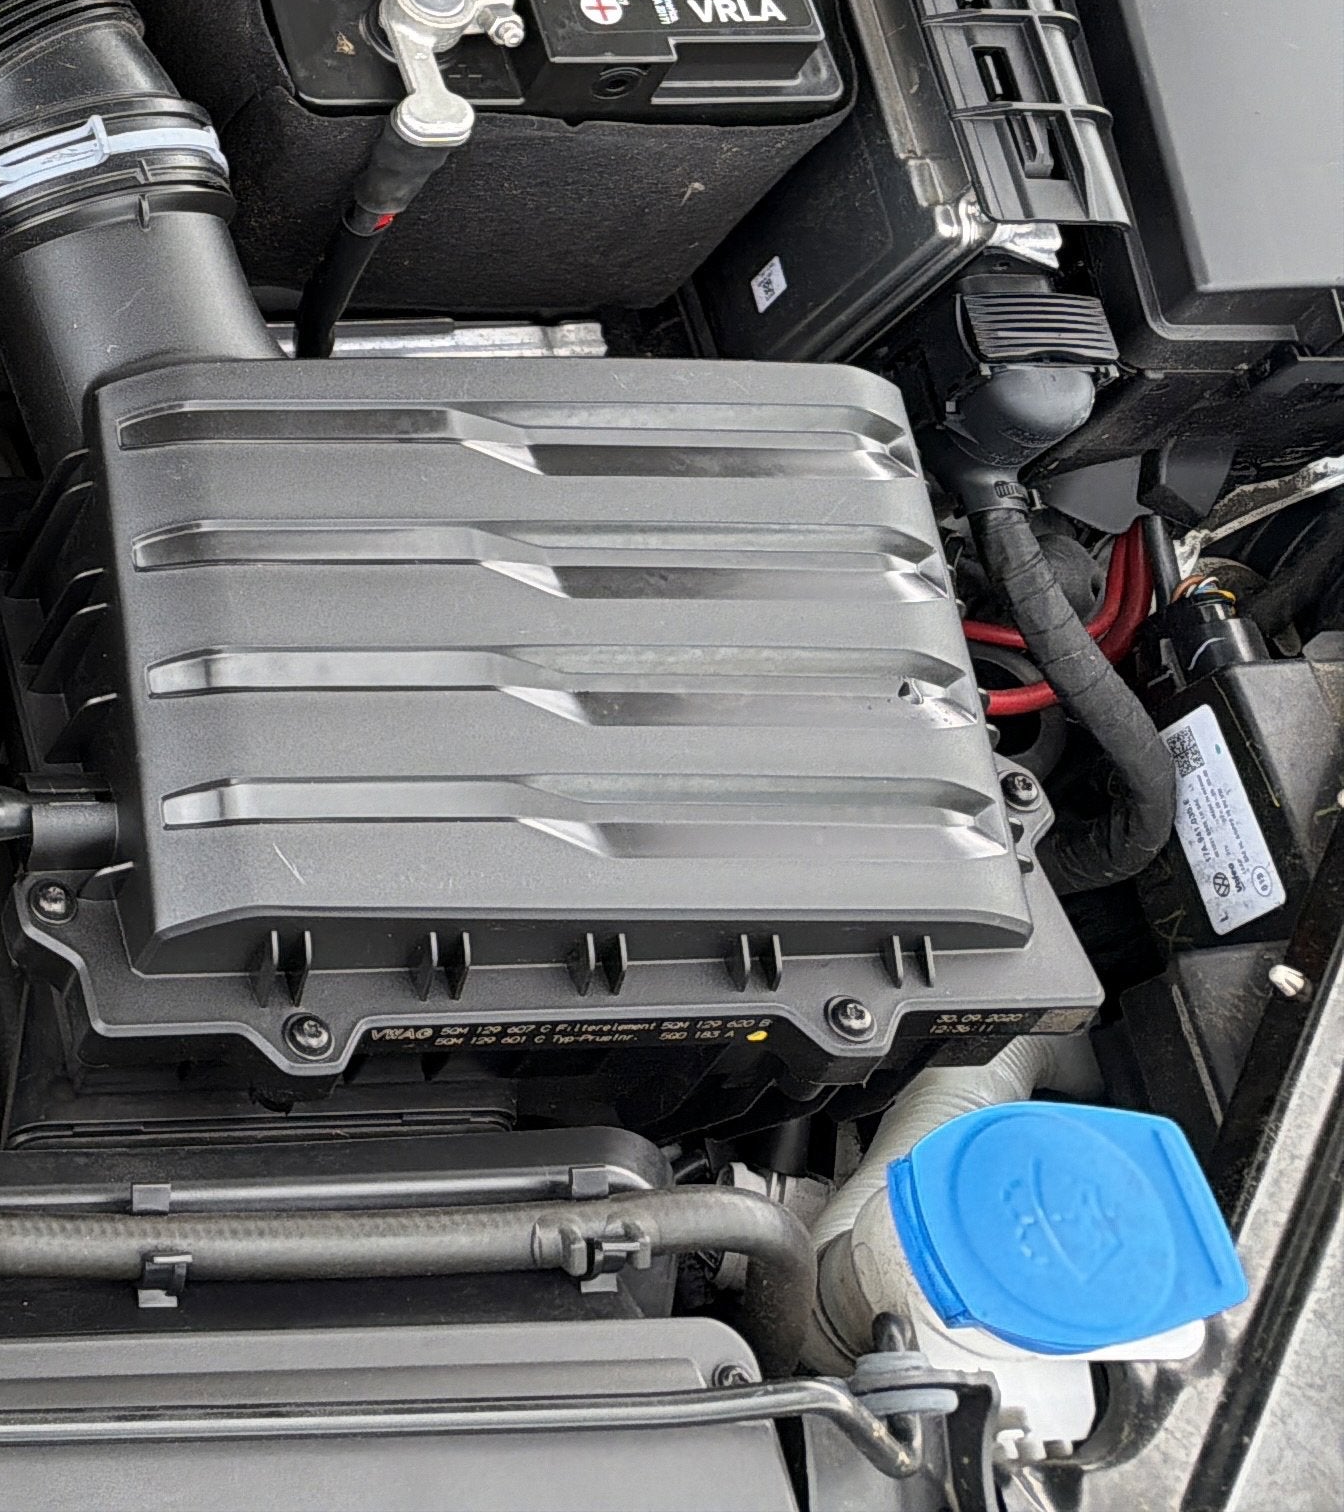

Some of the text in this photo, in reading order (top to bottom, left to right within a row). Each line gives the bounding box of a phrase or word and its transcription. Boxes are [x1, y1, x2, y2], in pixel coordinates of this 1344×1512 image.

[936, 1013, 1023, 1022] 30.09.2020
[475, 1024, 501, 1035] 129
[506, 1024, 535, 1034] 607
[556, 1021, 657, 1034] Filterelement
[695, 1018, 722, 1029] 129
[726, 1019, 755, 1028] 620
[929, 1024, 993, 1033] 12:36:11
[469, 1035, 496, 1045] 129
[500, 1035, 527, 1044] 601
[694, 1029, 720, 1039] 183
